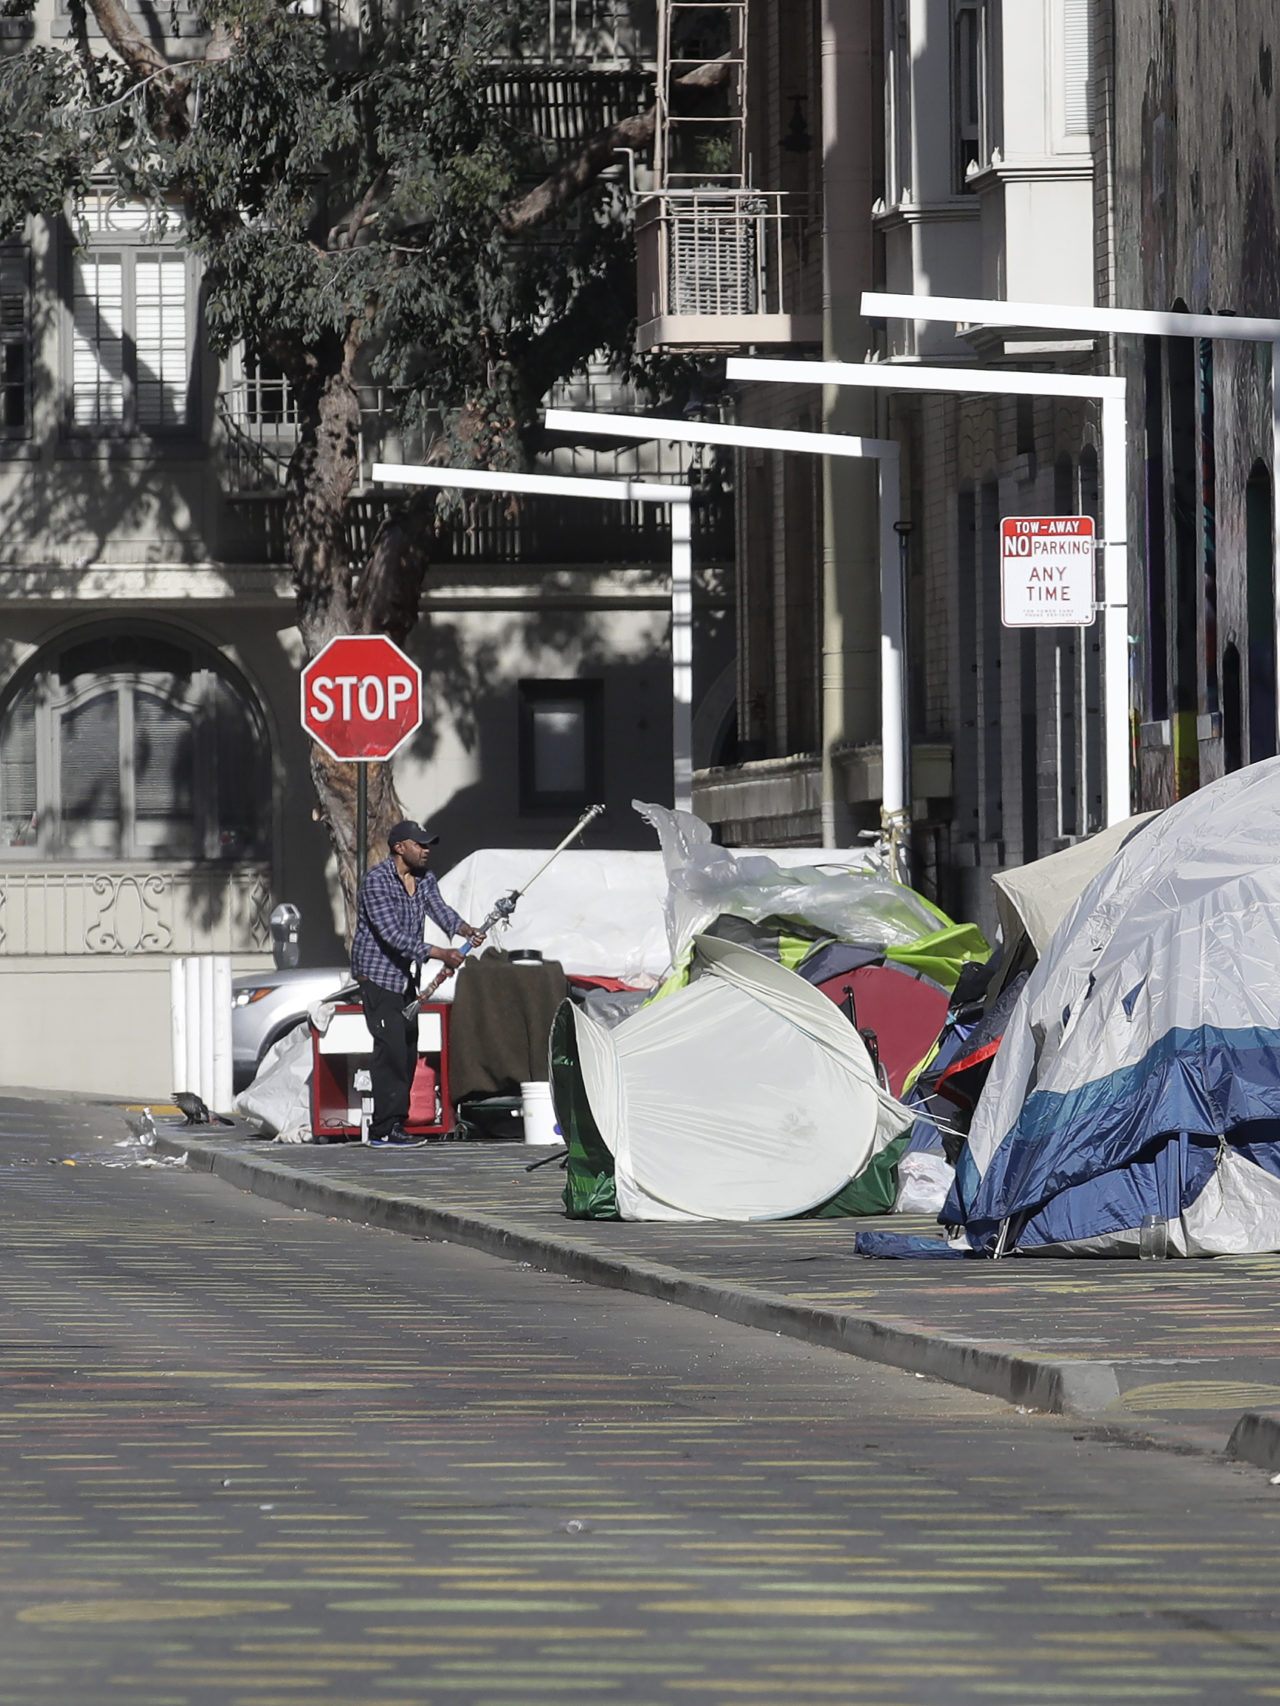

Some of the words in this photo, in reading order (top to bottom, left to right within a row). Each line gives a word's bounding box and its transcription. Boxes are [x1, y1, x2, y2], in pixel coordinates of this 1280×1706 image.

[1015, 520, 1080, 534] TOW-AWAY
[1004, 535, 1030, 556] NO
[1033, 540, 1090, 555] PARKING
[1029, 566, 1067, 582] ANY
[1026, 586, 1070, 601] TIME
[310, 674, 413, 722] STOP
